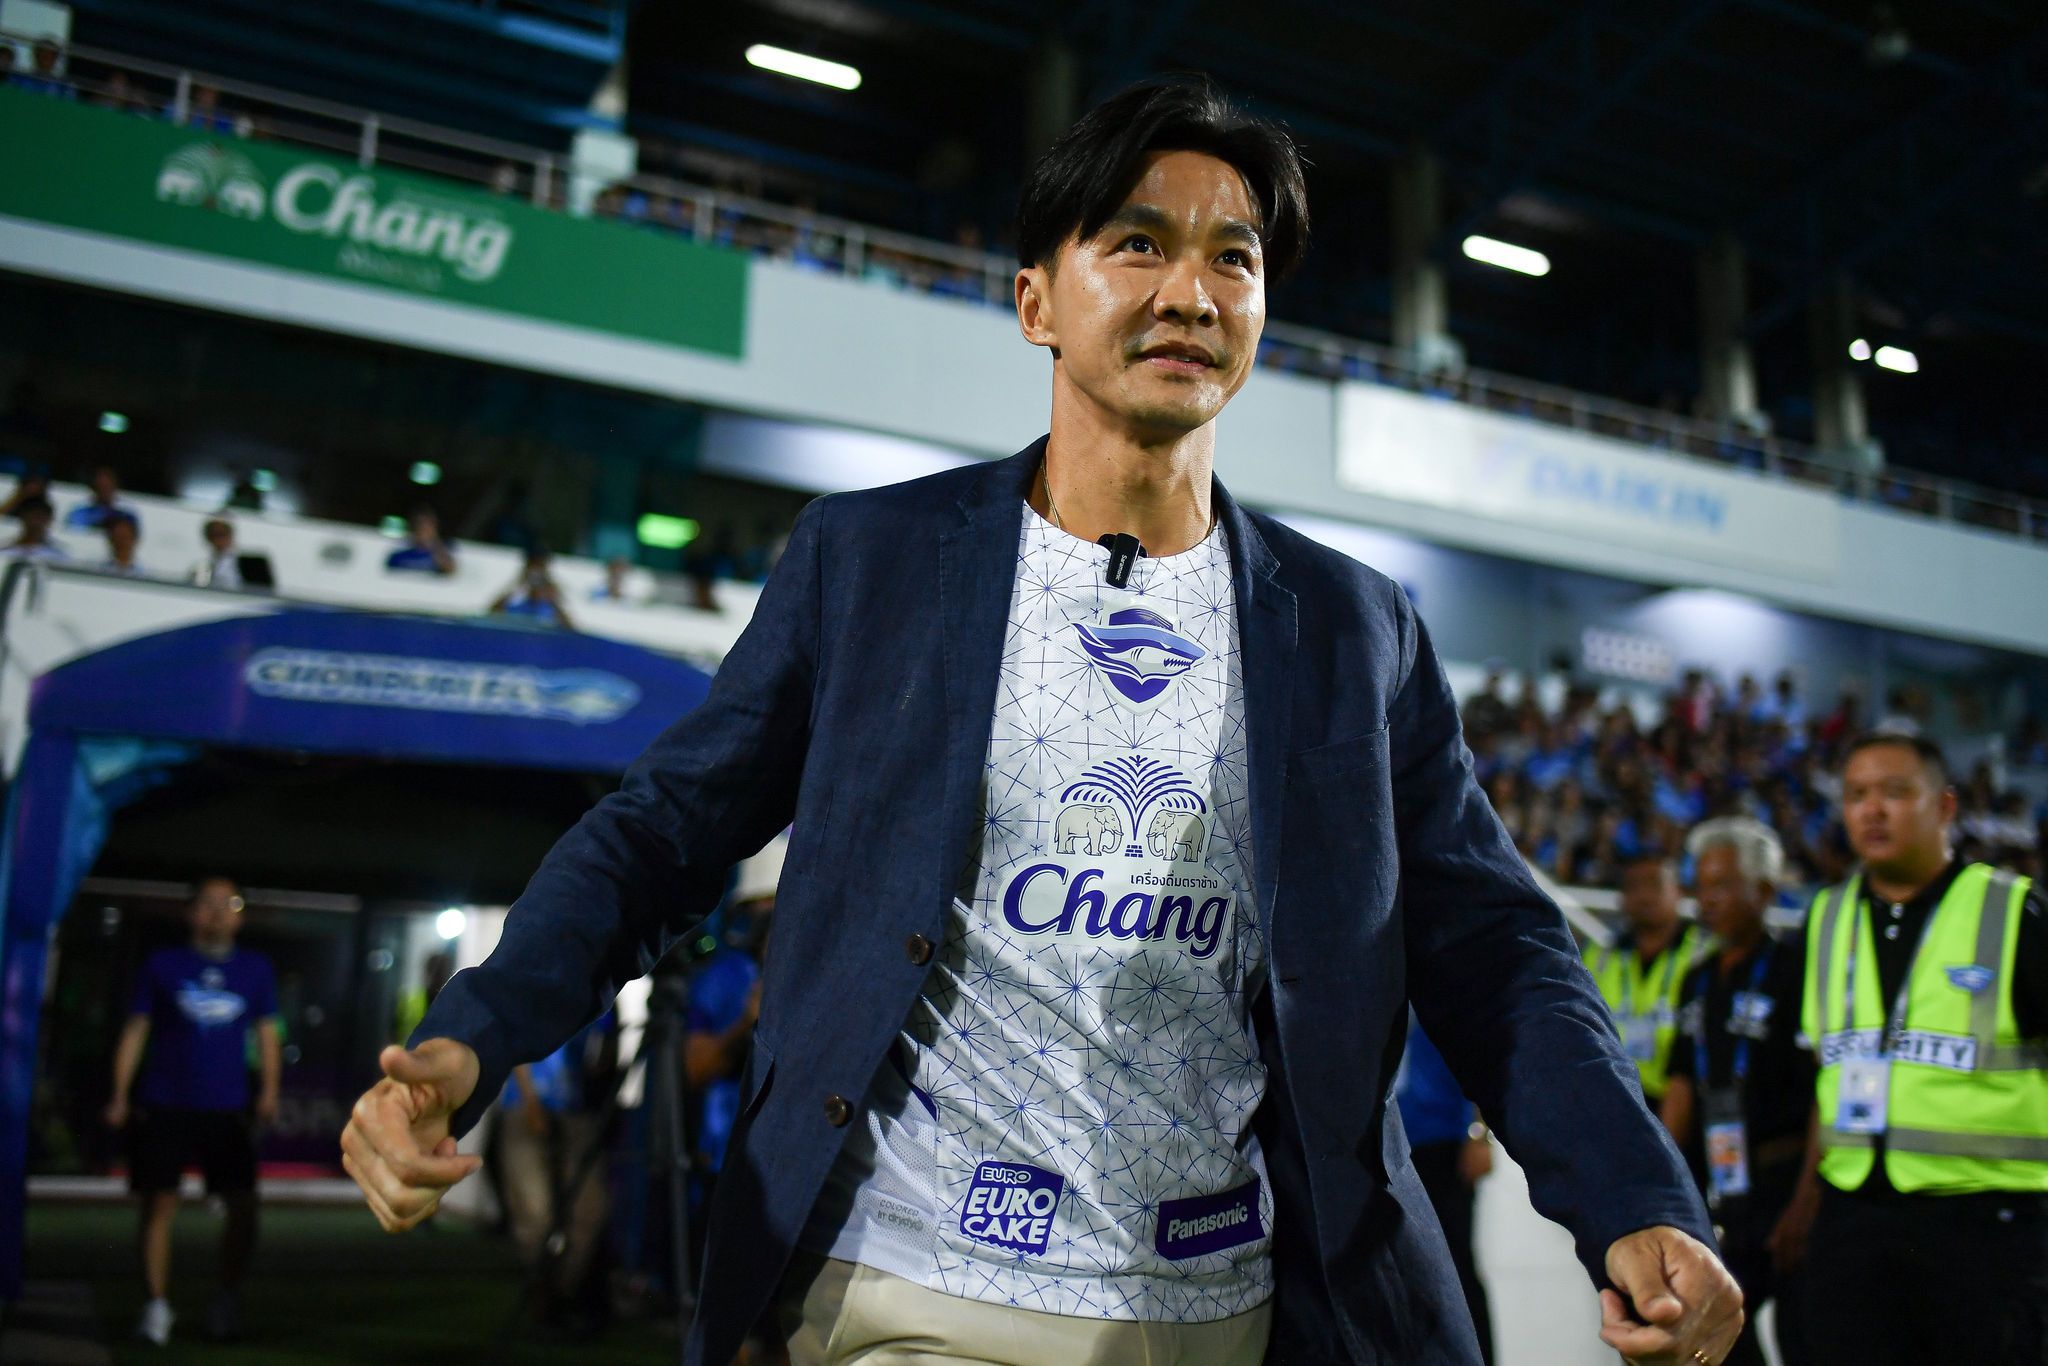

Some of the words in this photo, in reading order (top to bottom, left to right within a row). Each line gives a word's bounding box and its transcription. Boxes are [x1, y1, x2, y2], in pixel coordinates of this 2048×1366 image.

[272, 162, 512, 283] Chang
[1130, 868, 1218, 890] เครื่องดื่มตราช้าง
[1002, 862, 1232, 960] Chang
[981, 1166, 1031, 1184] EURO
[966, 1187, 1057, 1217] EURO
[963, 1215, 1049, 1245] CAKE
[1167, 1202, 1249, 1243] Panasonic
